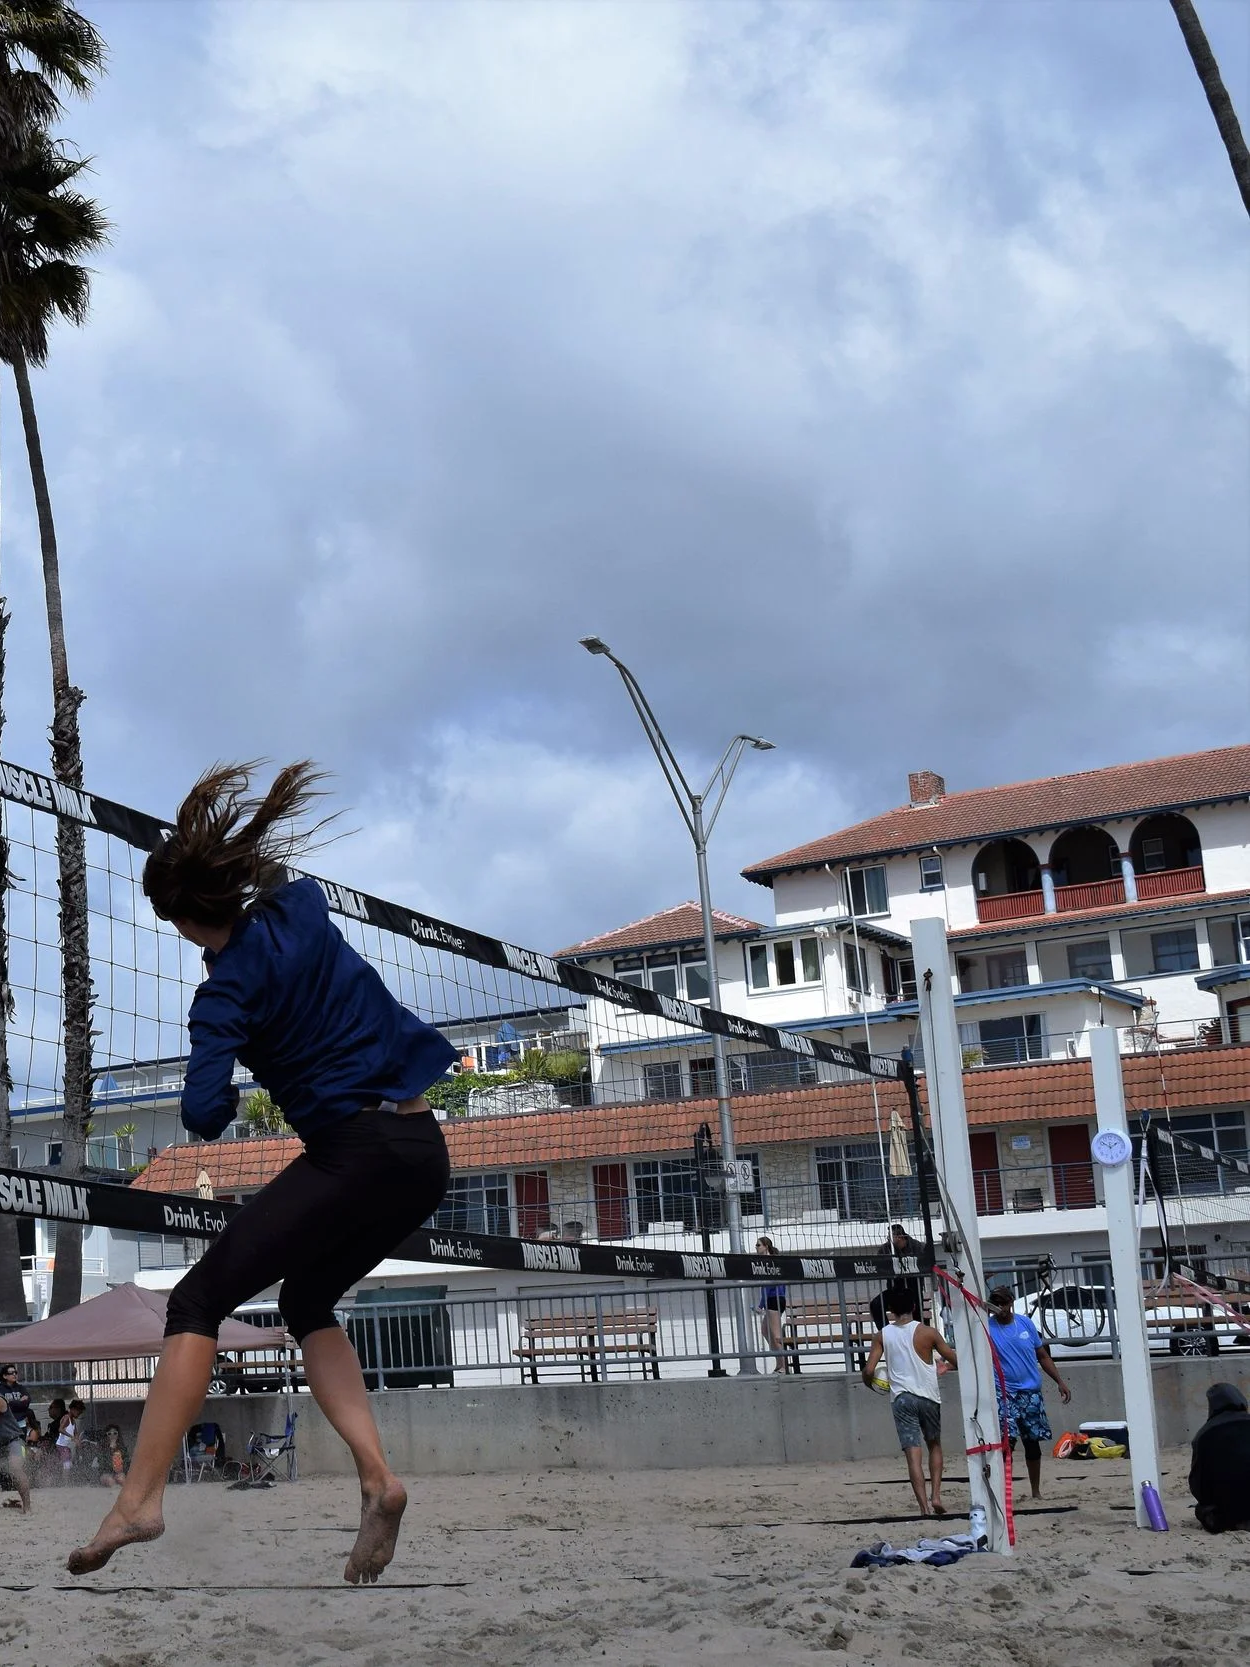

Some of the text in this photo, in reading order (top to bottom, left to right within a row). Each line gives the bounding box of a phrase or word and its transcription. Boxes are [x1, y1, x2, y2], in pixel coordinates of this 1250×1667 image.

[50, 780, 97, 824] MILK
[45, 1181, 90, 1221] MILK
[520, 1242, 582, 1272] MUSCLE MILK
[681, 1255, 727, 1278] MUSCLE MILK
